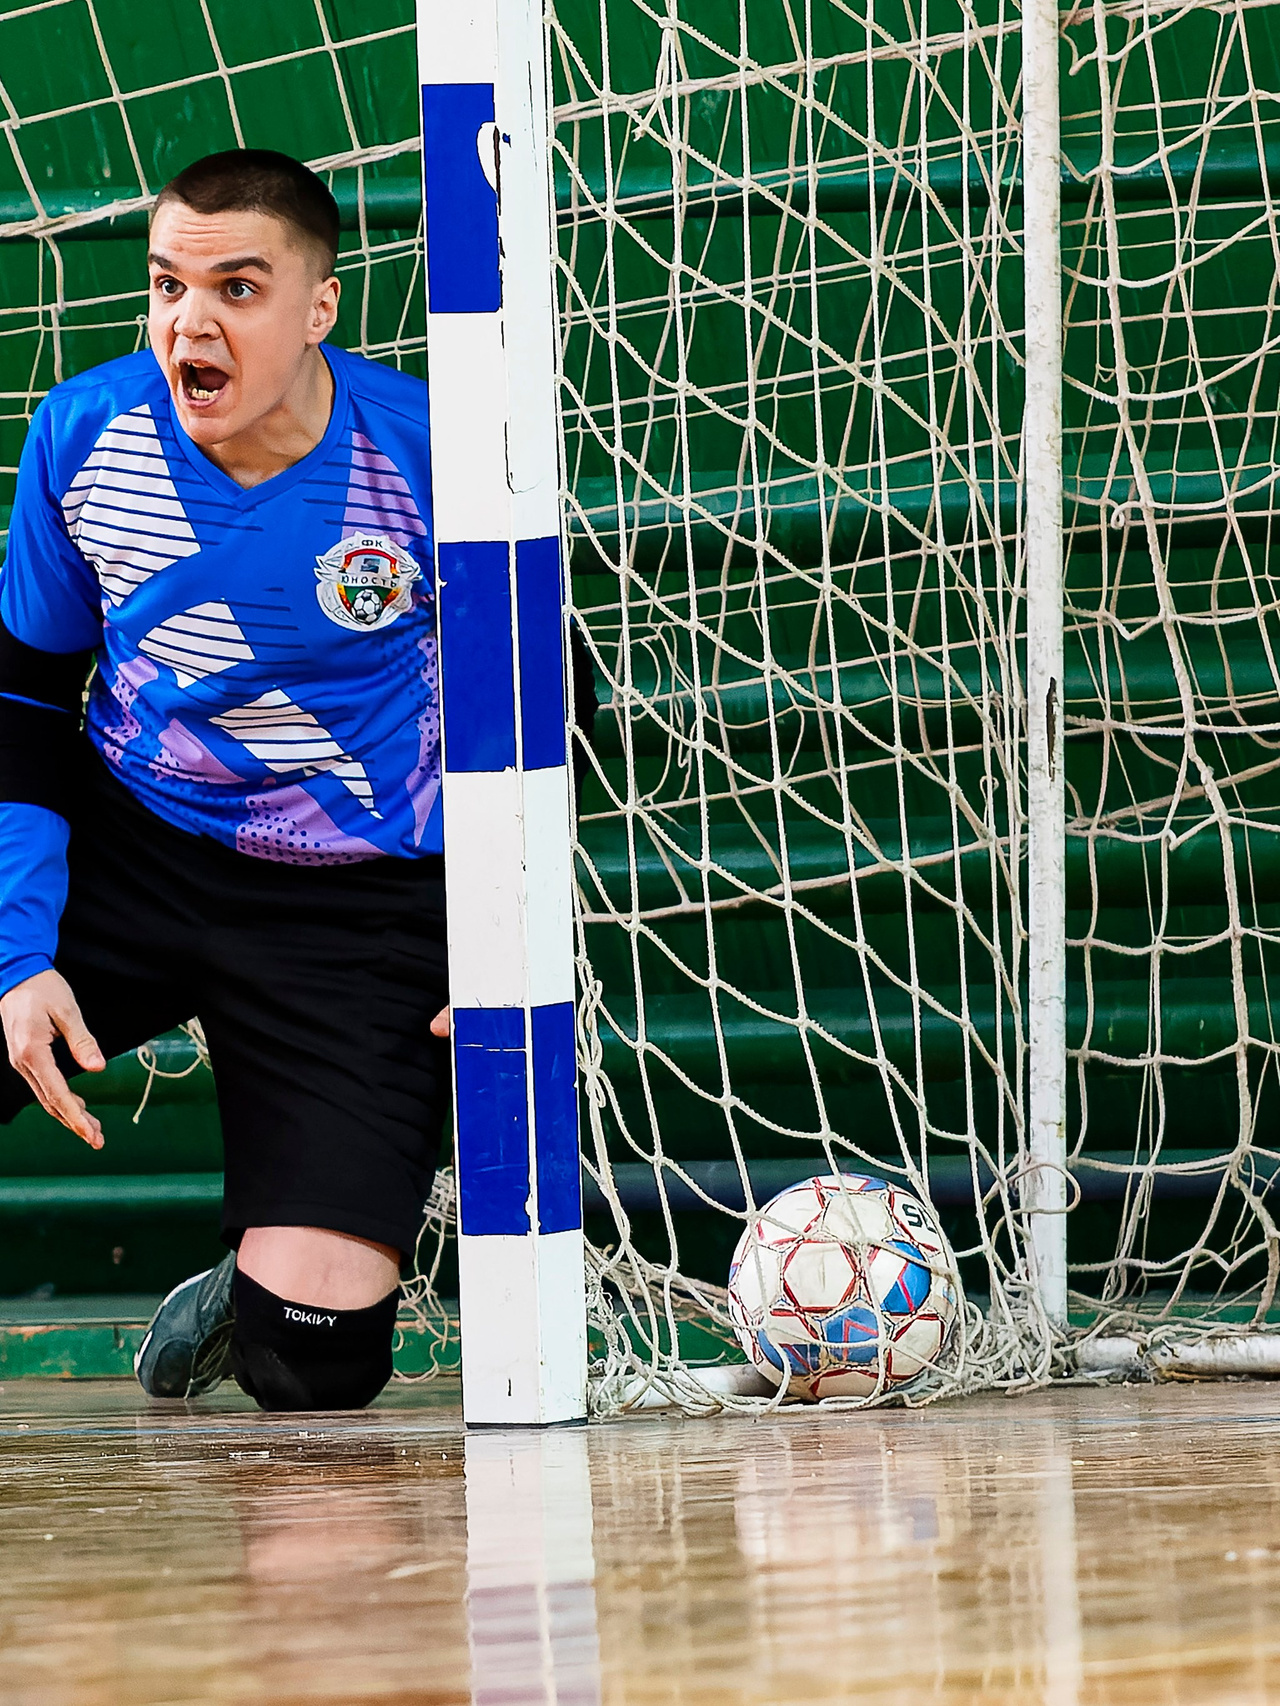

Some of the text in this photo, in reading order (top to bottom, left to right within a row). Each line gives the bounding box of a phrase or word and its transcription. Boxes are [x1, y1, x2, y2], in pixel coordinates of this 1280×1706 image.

[361, 539, 383, 548] ФК
[341, 575, 397, 588] ЮНОСТЬ
[283, 1306, 338, 1327] TOKIVY
